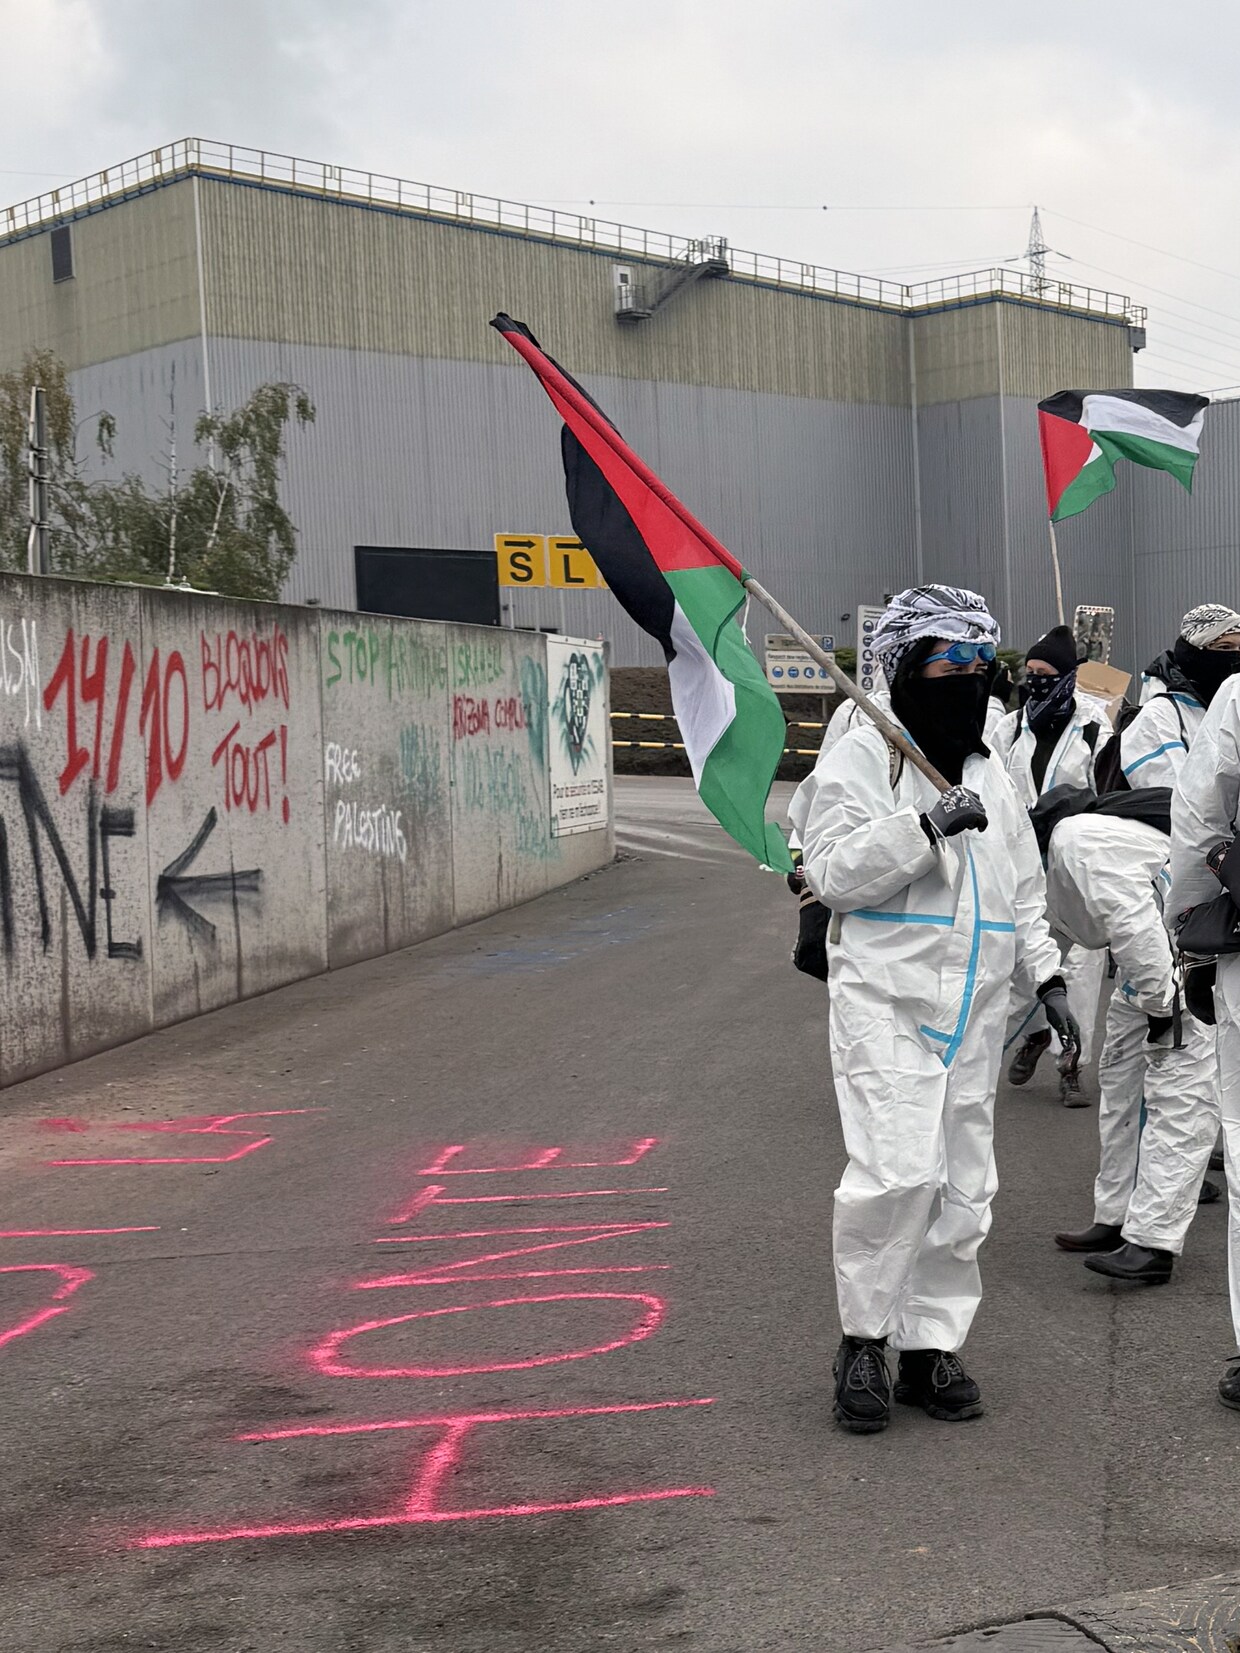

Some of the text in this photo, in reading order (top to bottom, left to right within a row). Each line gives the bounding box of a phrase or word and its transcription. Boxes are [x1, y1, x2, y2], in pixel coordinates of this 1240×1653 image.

[509, 551, 534, 582] S
[563, 554, 585, 583] L
[201, 621, 290, 716] BLOQUONS
[325, 628, 381, 690] STOP
[43, 627, 190, 808] 14/10
[325, 742, 361, 788] FREE
[128, 1136, 717, 1548] HONTE
